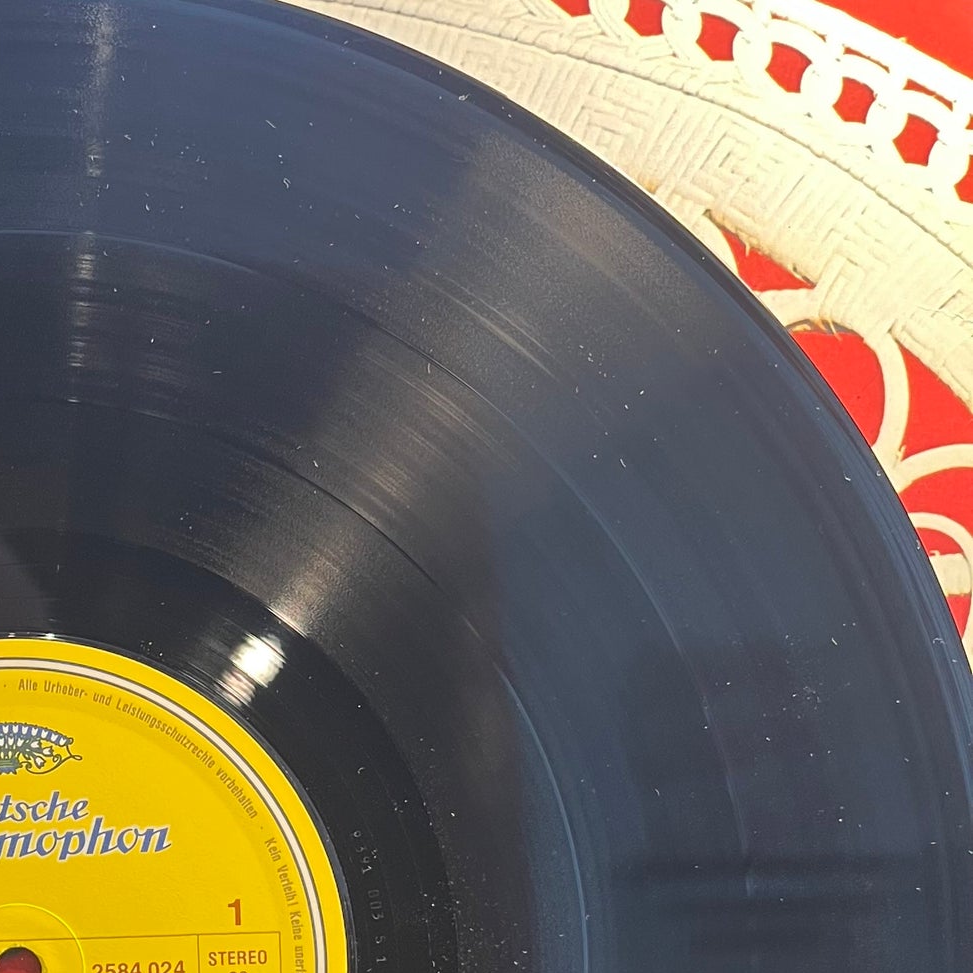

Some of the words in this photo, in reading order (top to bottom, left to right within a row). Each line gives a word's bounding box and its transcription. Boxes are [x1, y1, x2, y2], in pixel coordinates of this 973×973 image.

[19, 679, 37, 691] Alle
[44, 680, 87, 698] Urheber-
[93, 693, 112, 706] und
[216, 768, 257, 818] vorbehalten
[228, 899, 241, 925] 1
[265, 837, 281, 861] Kein
[278, 865, 298, 906] Verleih!
[290, 911, 303, 940] Keine
[208, 950, 267, 966] STEREO
